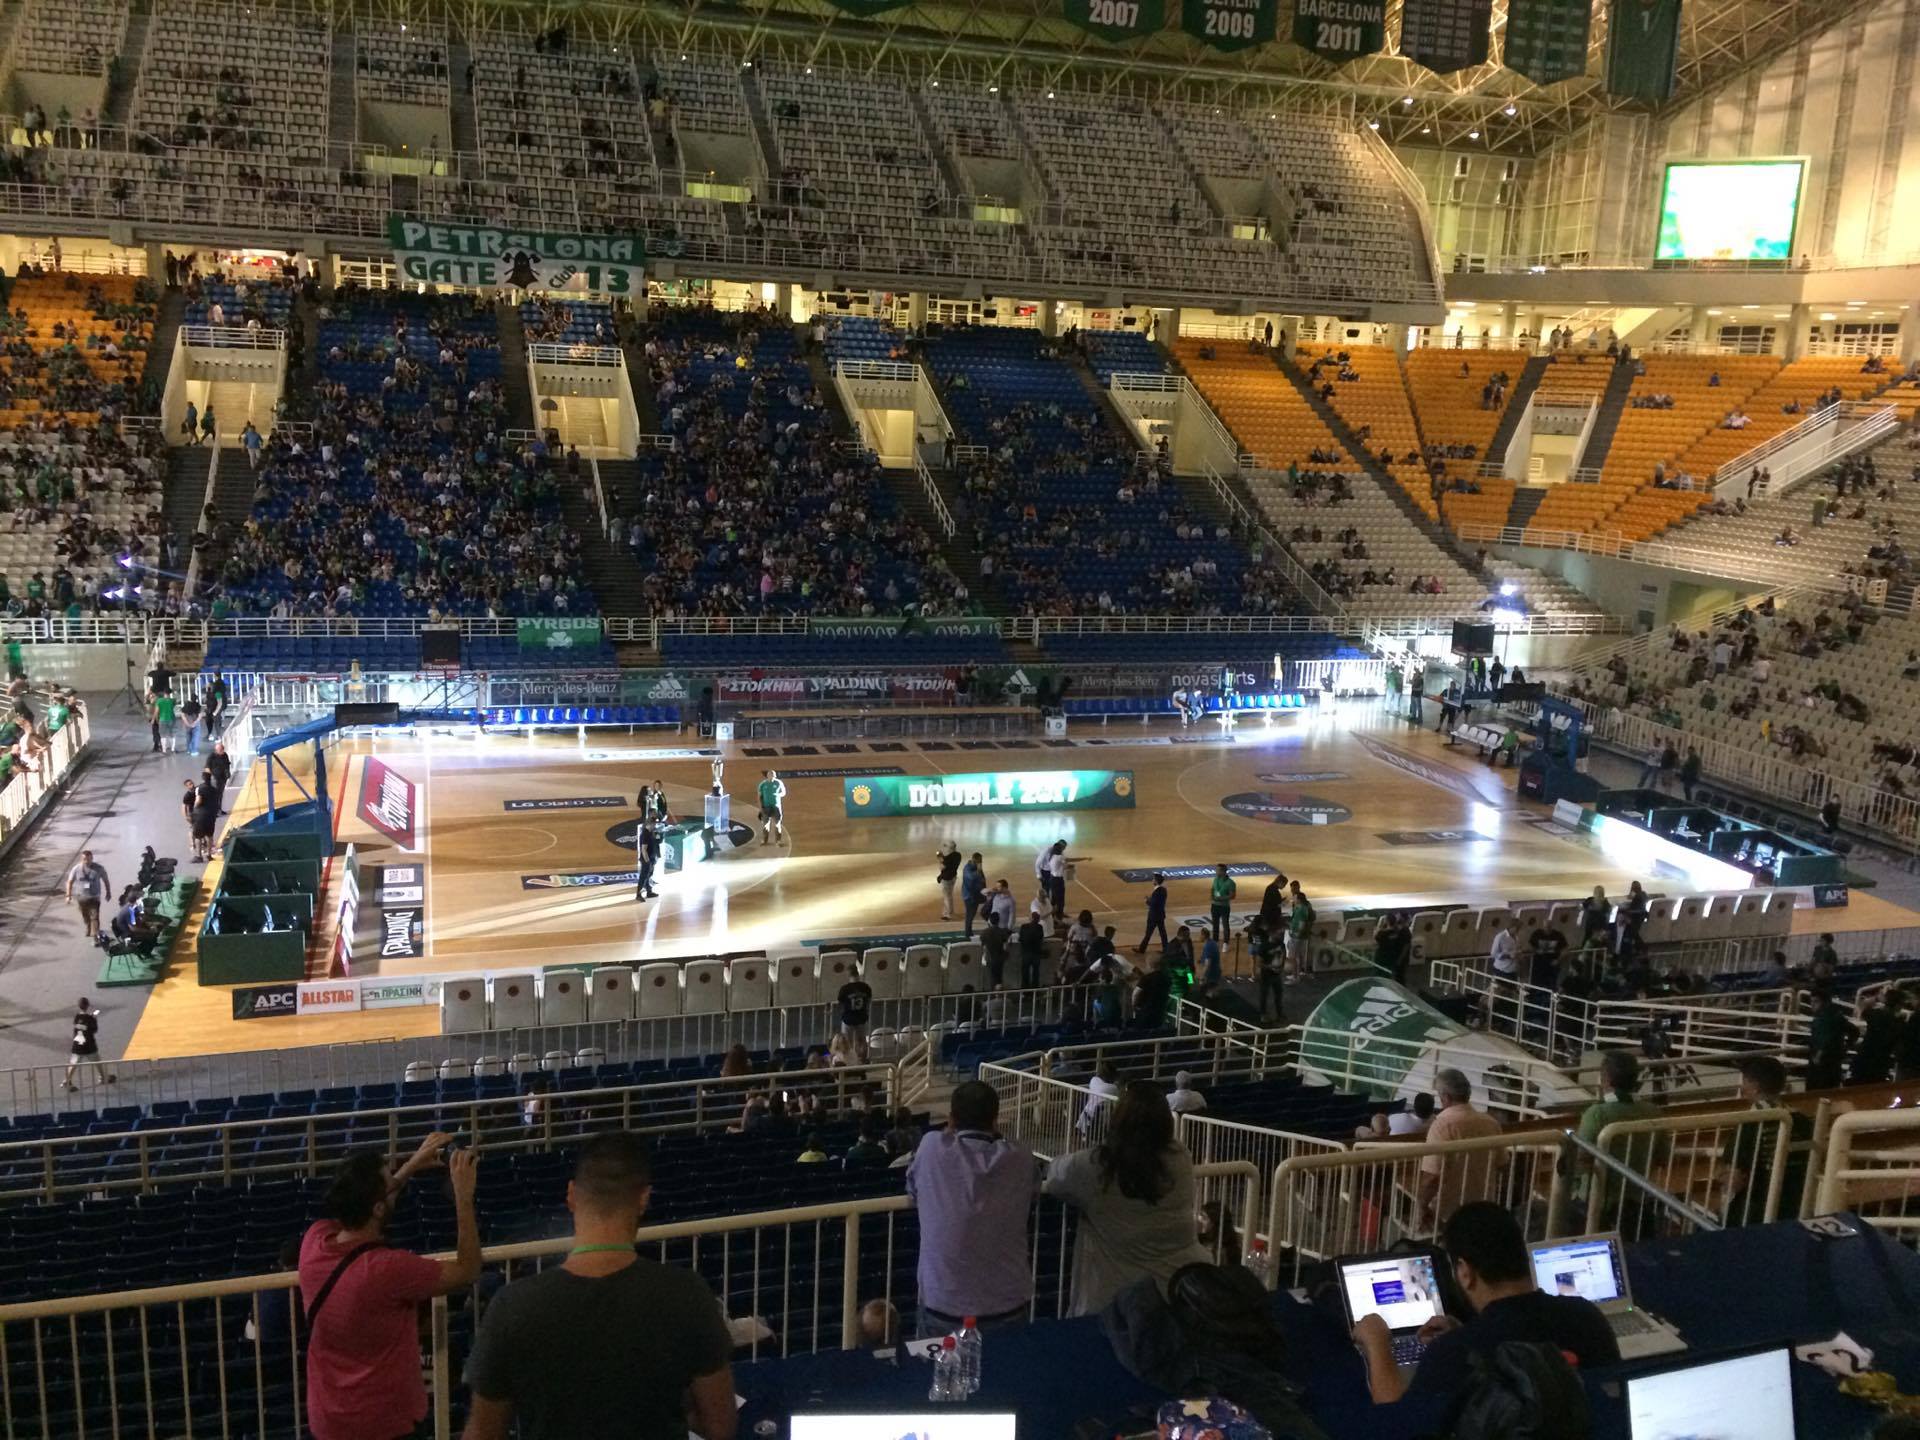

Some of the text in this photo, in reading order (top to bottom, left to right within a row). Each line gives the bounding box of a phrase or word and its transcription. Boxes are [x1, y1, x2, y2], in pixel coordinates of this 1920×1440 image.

[1089, 0, 1139, 28] 2007
[1299, 0, 1382, 23] BARCELONA
[1205, 9, 1255, 38] 2009
[1316, 22, 1361, 52] 2011
[402, 221, 633, 261] PETRALONA
[404, 256, 630, 293] GATE Club 13
[516, 617, 600, 630] PYRGOS
[523, 681, 617, 695] Mercedes-Benz
[1082, 675, 1160, 687] Mercedes-Benz
[648, 689, 689, 700] adidas
[908, 779, 1014, 808] DOUBLE
[382, 911, 415, 956] SPALDING
[254, 992, 294, 1008] APC
[302, 989, 354, 1005] ALLSTAR
[850, 997, 864, 1011] 13
